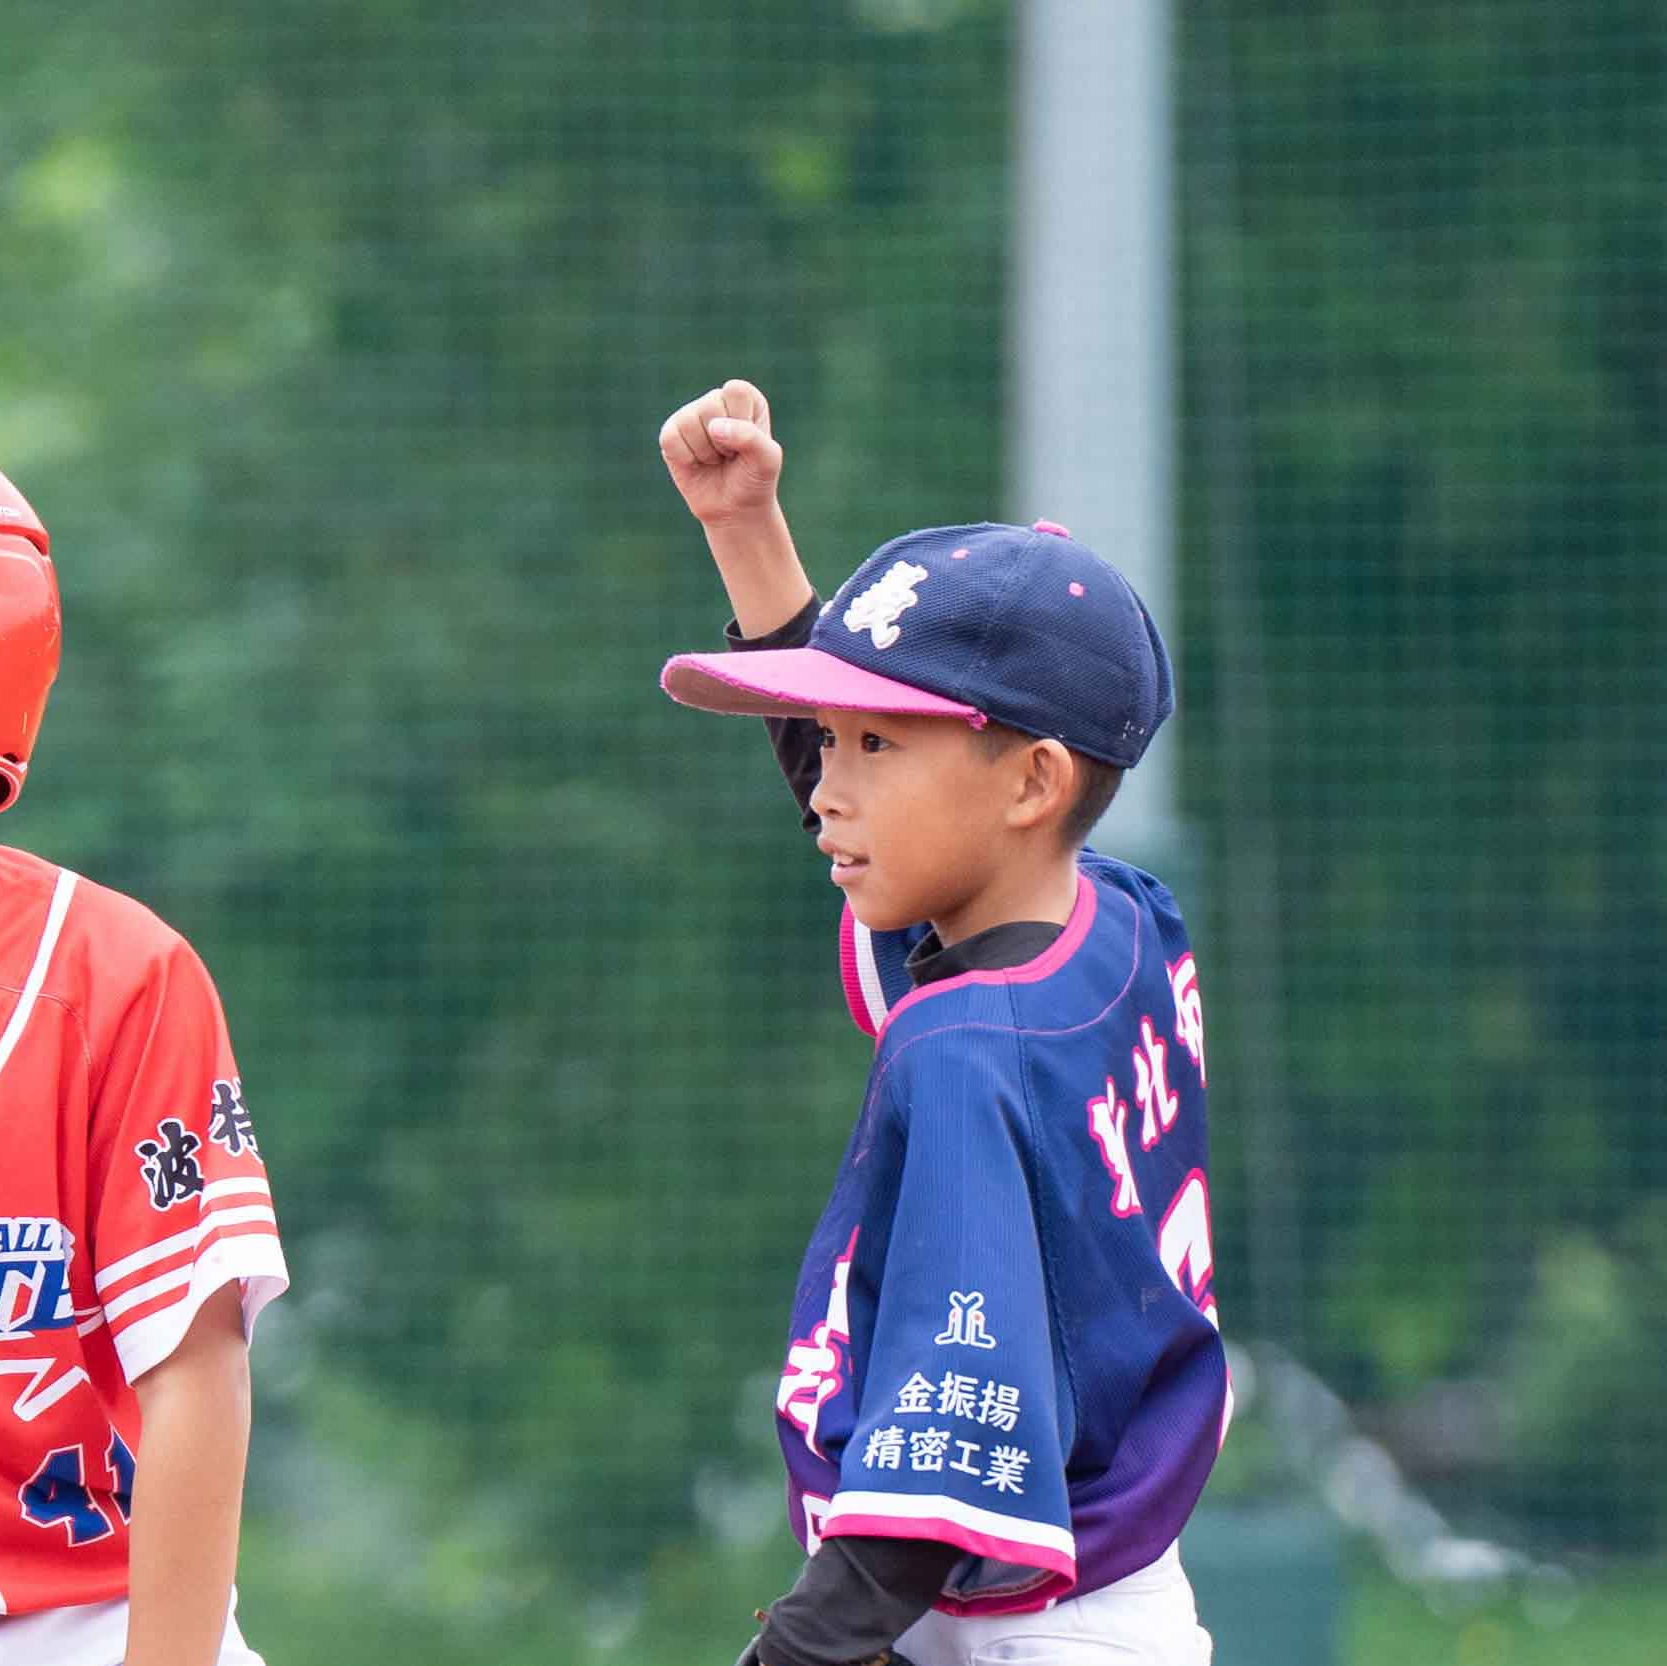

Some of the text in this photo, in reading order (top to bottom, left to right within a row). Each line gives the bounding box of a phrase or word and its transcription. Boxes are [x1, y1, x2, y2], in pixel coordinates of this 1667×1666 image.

[893, 1370, 1022, 1433] 金振揚
[861, 1423, 1032, 1496] 精密工業
